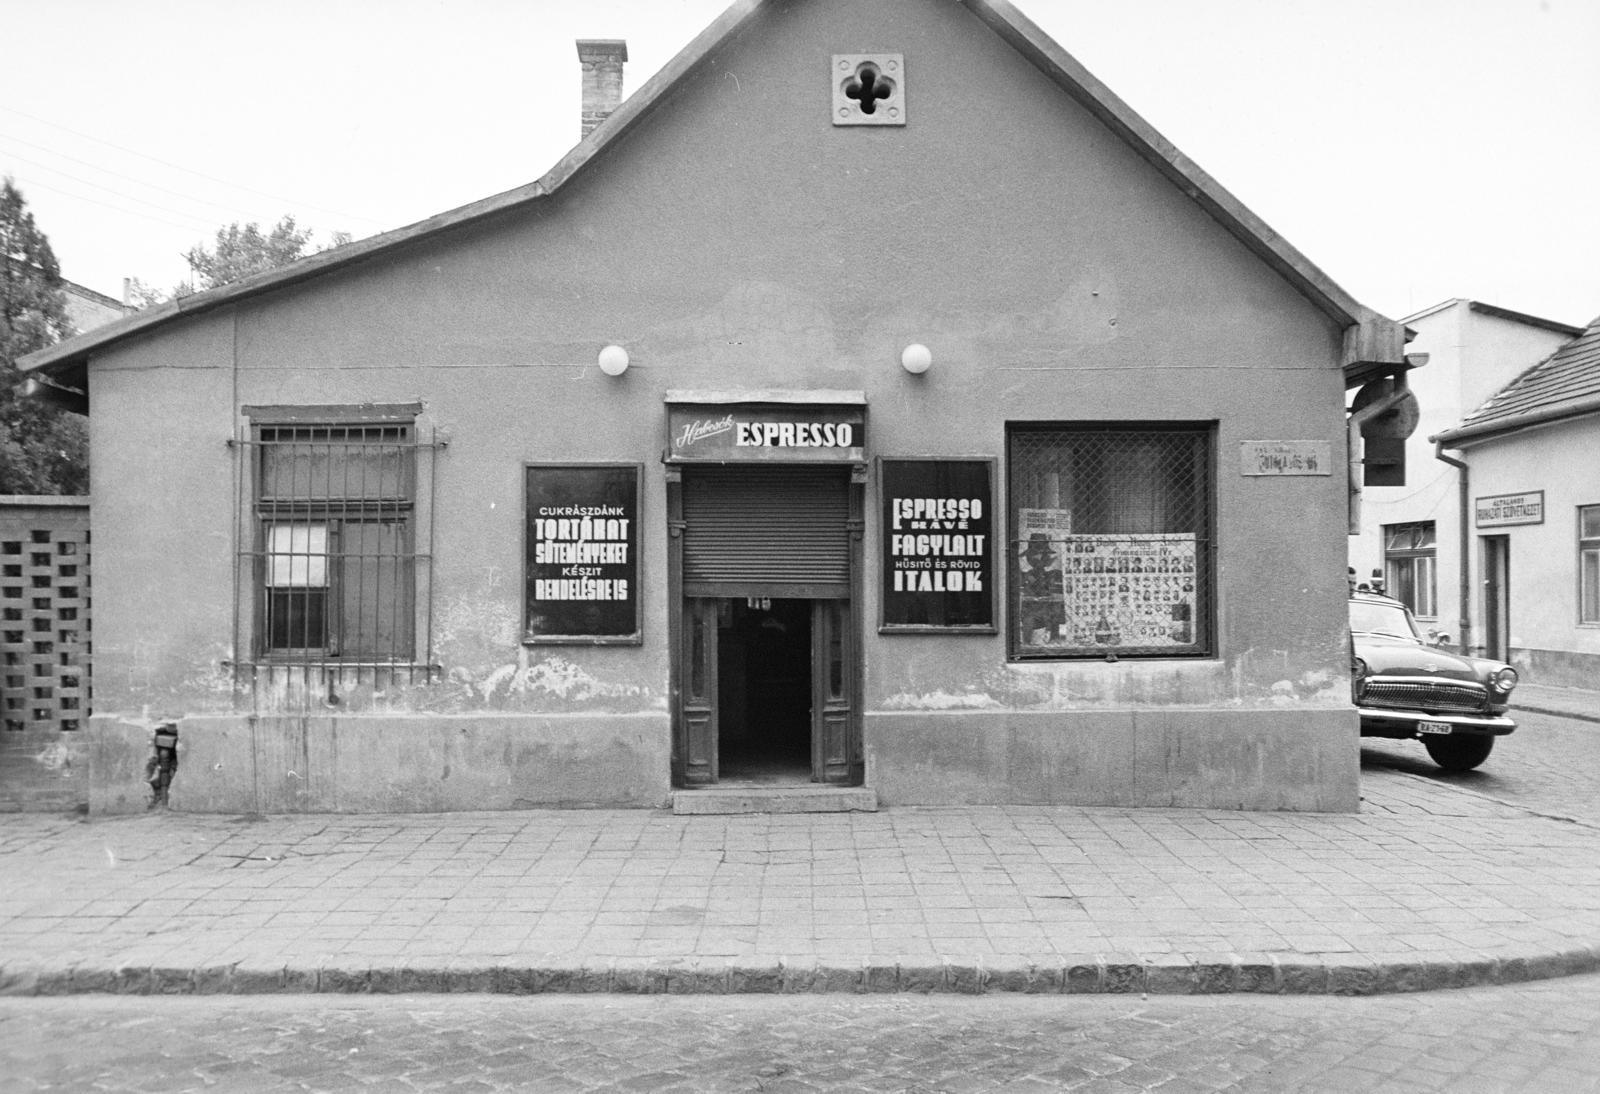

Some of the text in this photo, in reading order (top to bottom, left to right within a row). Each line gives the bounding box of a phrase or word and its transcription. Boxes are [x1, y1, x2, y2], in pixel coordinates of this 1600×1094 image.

[736, 422, 853, 447] ESPRESSO
[539, 504, 625, 516] CUKRÁSZDÁNK
[892, 498, 982, 530] ESPRESSO
[535, 516, 629, 540] TORTÁKAT
[911, 518, 969, 530] KÁVÉ
[535, 540, 629, 564] SÜTEMÉNYEKET
[892, 534, 985, 556] FAGYLALT
[562, 564, 602, 576] KÉSZIT
[935, 558, 947, 569] ÉS
[950, 559, 981, 569] RÖVID
[535, 576, 628, 601] RENDELÉSRE IS
[894, 570, 983, 592] ITALOK
